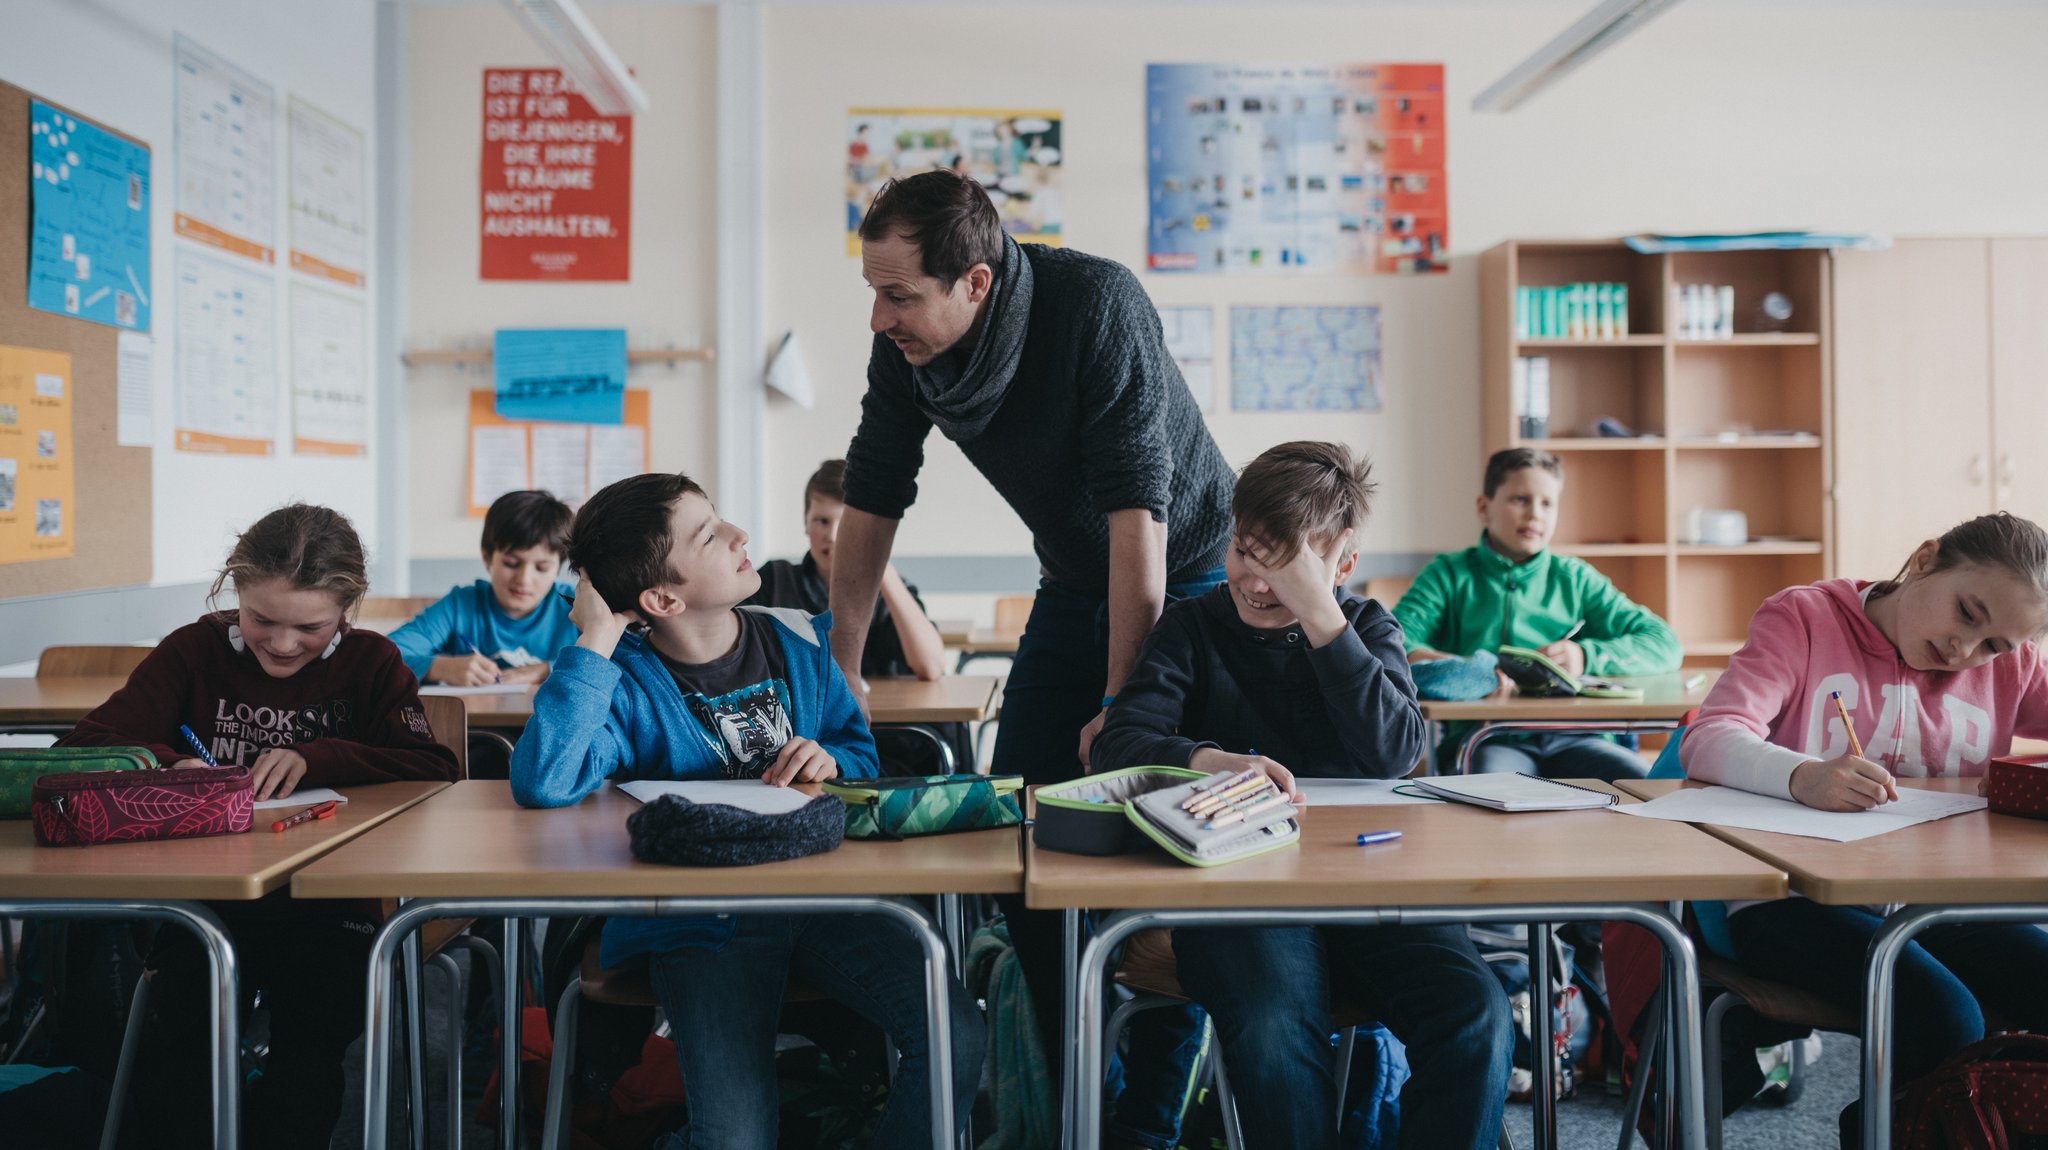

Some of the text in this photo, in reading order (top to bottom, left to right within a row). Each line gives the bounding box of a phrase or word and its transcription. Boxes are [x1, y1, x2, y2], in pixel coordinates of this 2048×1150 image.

[487, 73, 575, 93] DIE REA
[487, 95, 568, 117] IST FÜR
[486, 120, 623, 145] DIEJENIGEN,
[503, 143, 596, 164] DIE IHRE
[504, 166, 594, 189] TRÄUME
[485, 191, 553, 212] NICHT
[484, 215, 617, 237] AUSHALTEN.
[215, 721, 294, 747] THE IMPOS
[1806, 673, 1992, 778] GAP
[211, 736, 236, 760] IN
